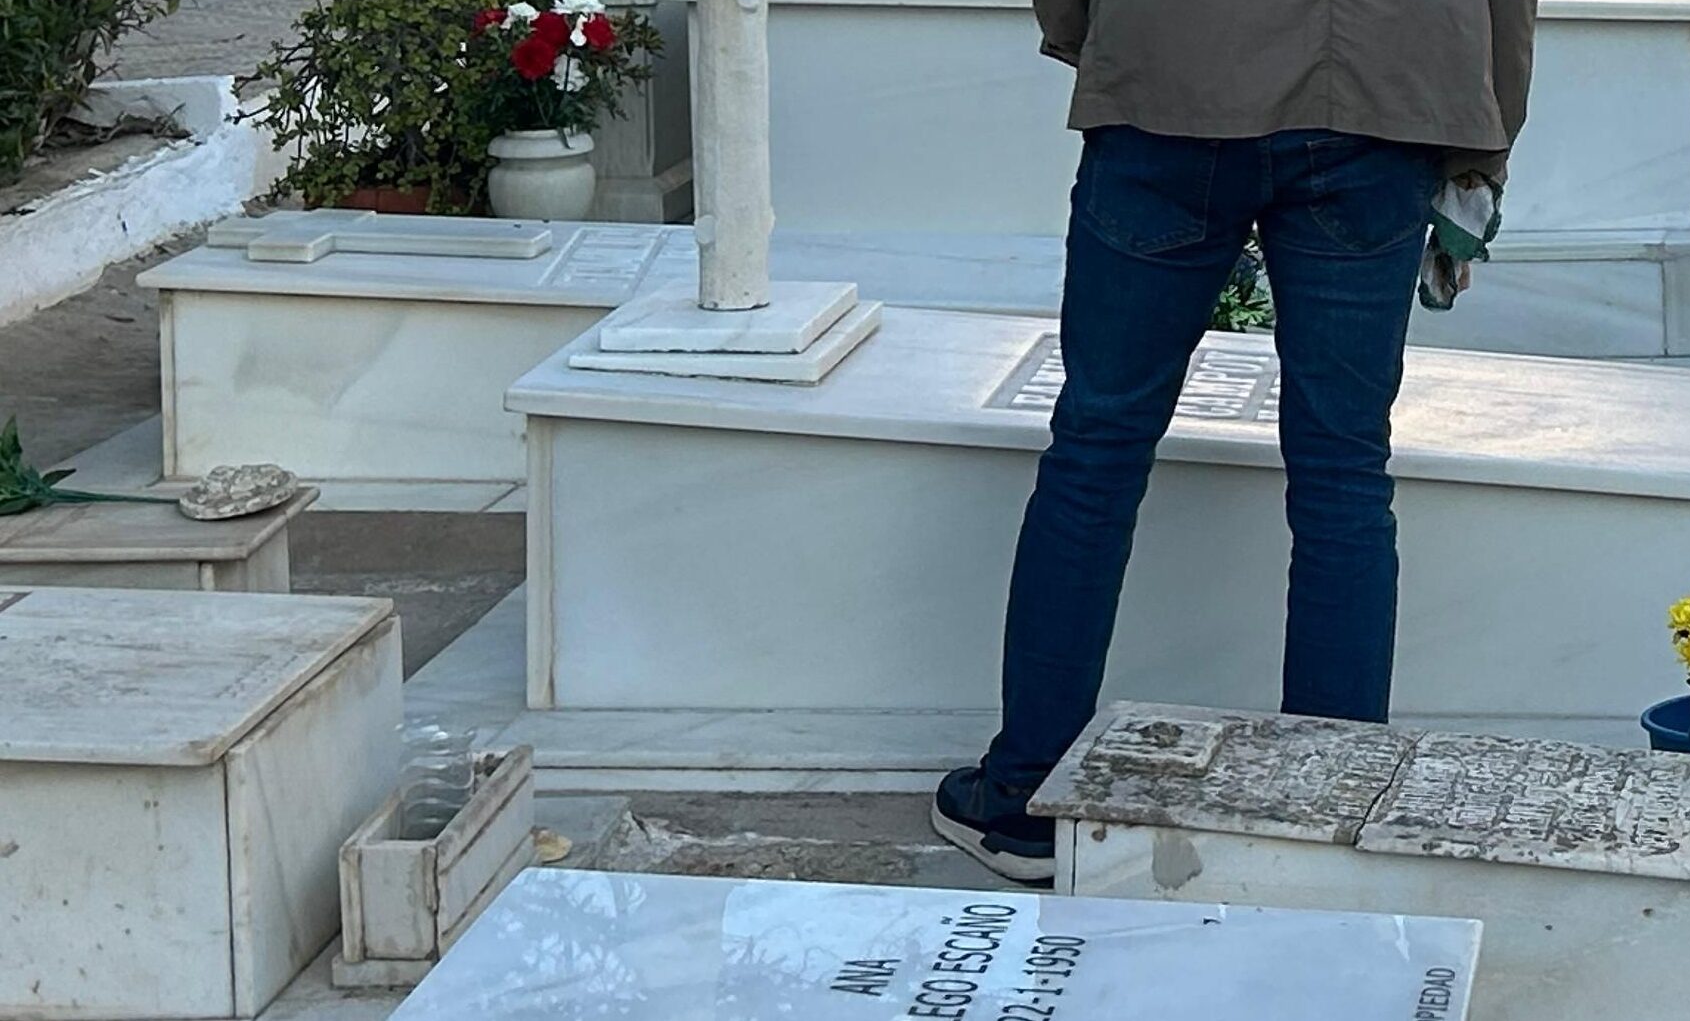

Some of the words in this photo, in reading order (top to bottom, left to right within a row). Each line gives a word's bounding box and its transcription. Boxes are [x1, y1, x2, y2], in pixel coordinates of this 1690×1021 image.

[932, 903, 1017, 975] ESCAÑO
[830, 958, 902, 997] ANA
[906, 978, 979, 1021] EGO
[1413, 967, 1456, 1021] PIEDAD
